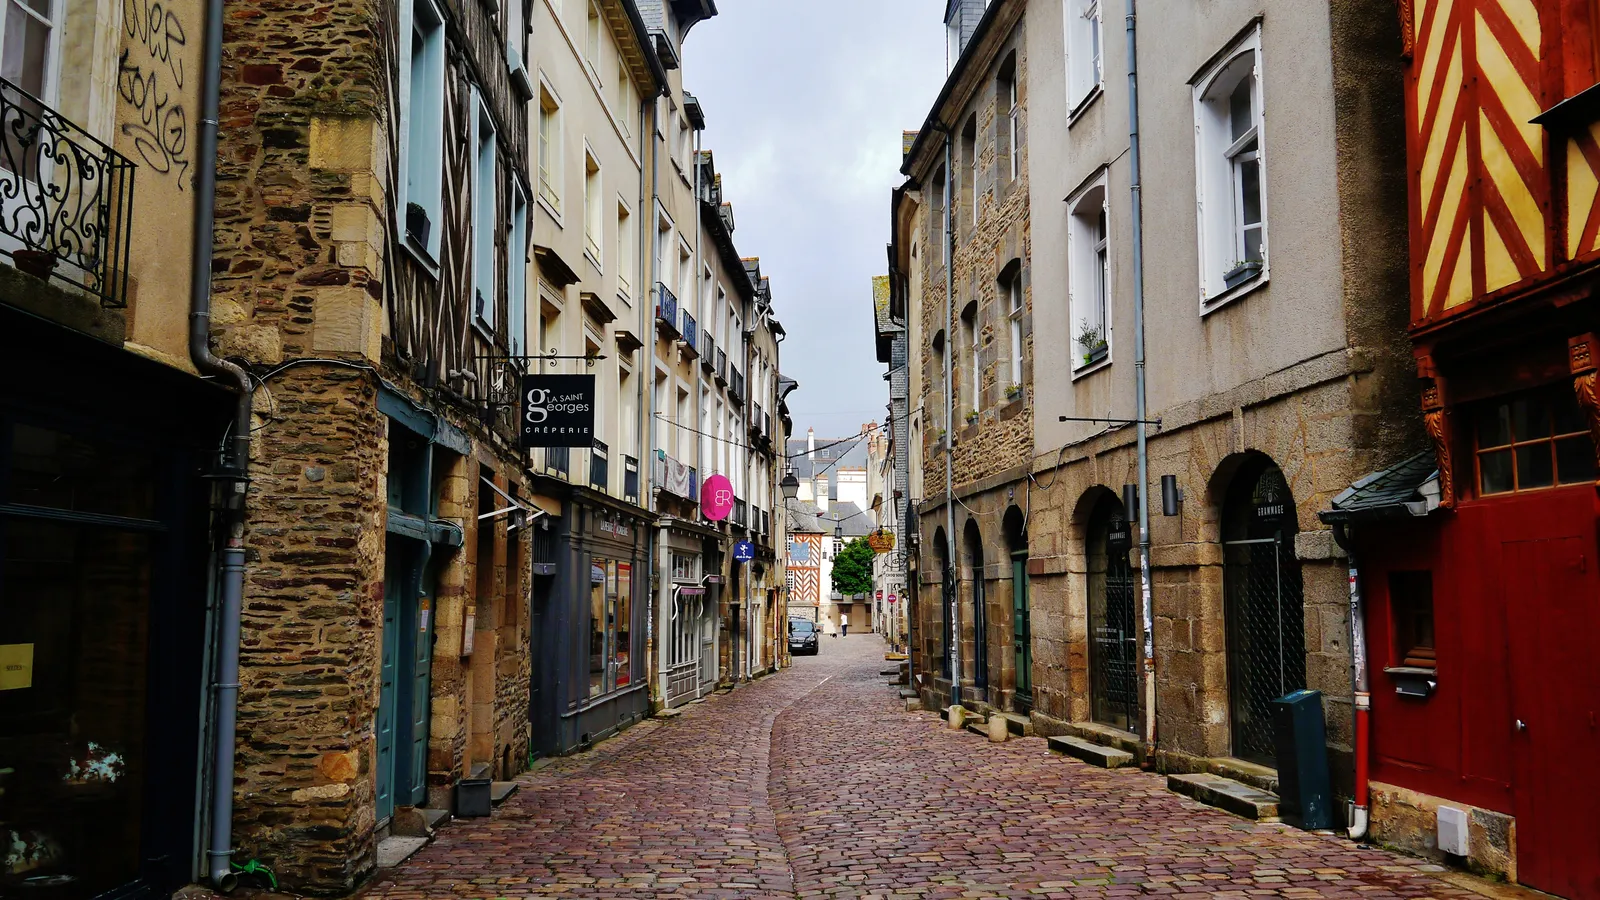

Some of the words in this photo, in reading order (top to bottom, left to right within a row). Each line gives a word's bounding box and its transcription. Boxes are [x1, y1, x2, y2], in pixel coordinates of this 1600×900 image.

[560, 393, 583, 402] SAINT
[525, 426, 589, 434] CRÊPERIE
[1257, 504, 1284, 517] GRAMMAGE
